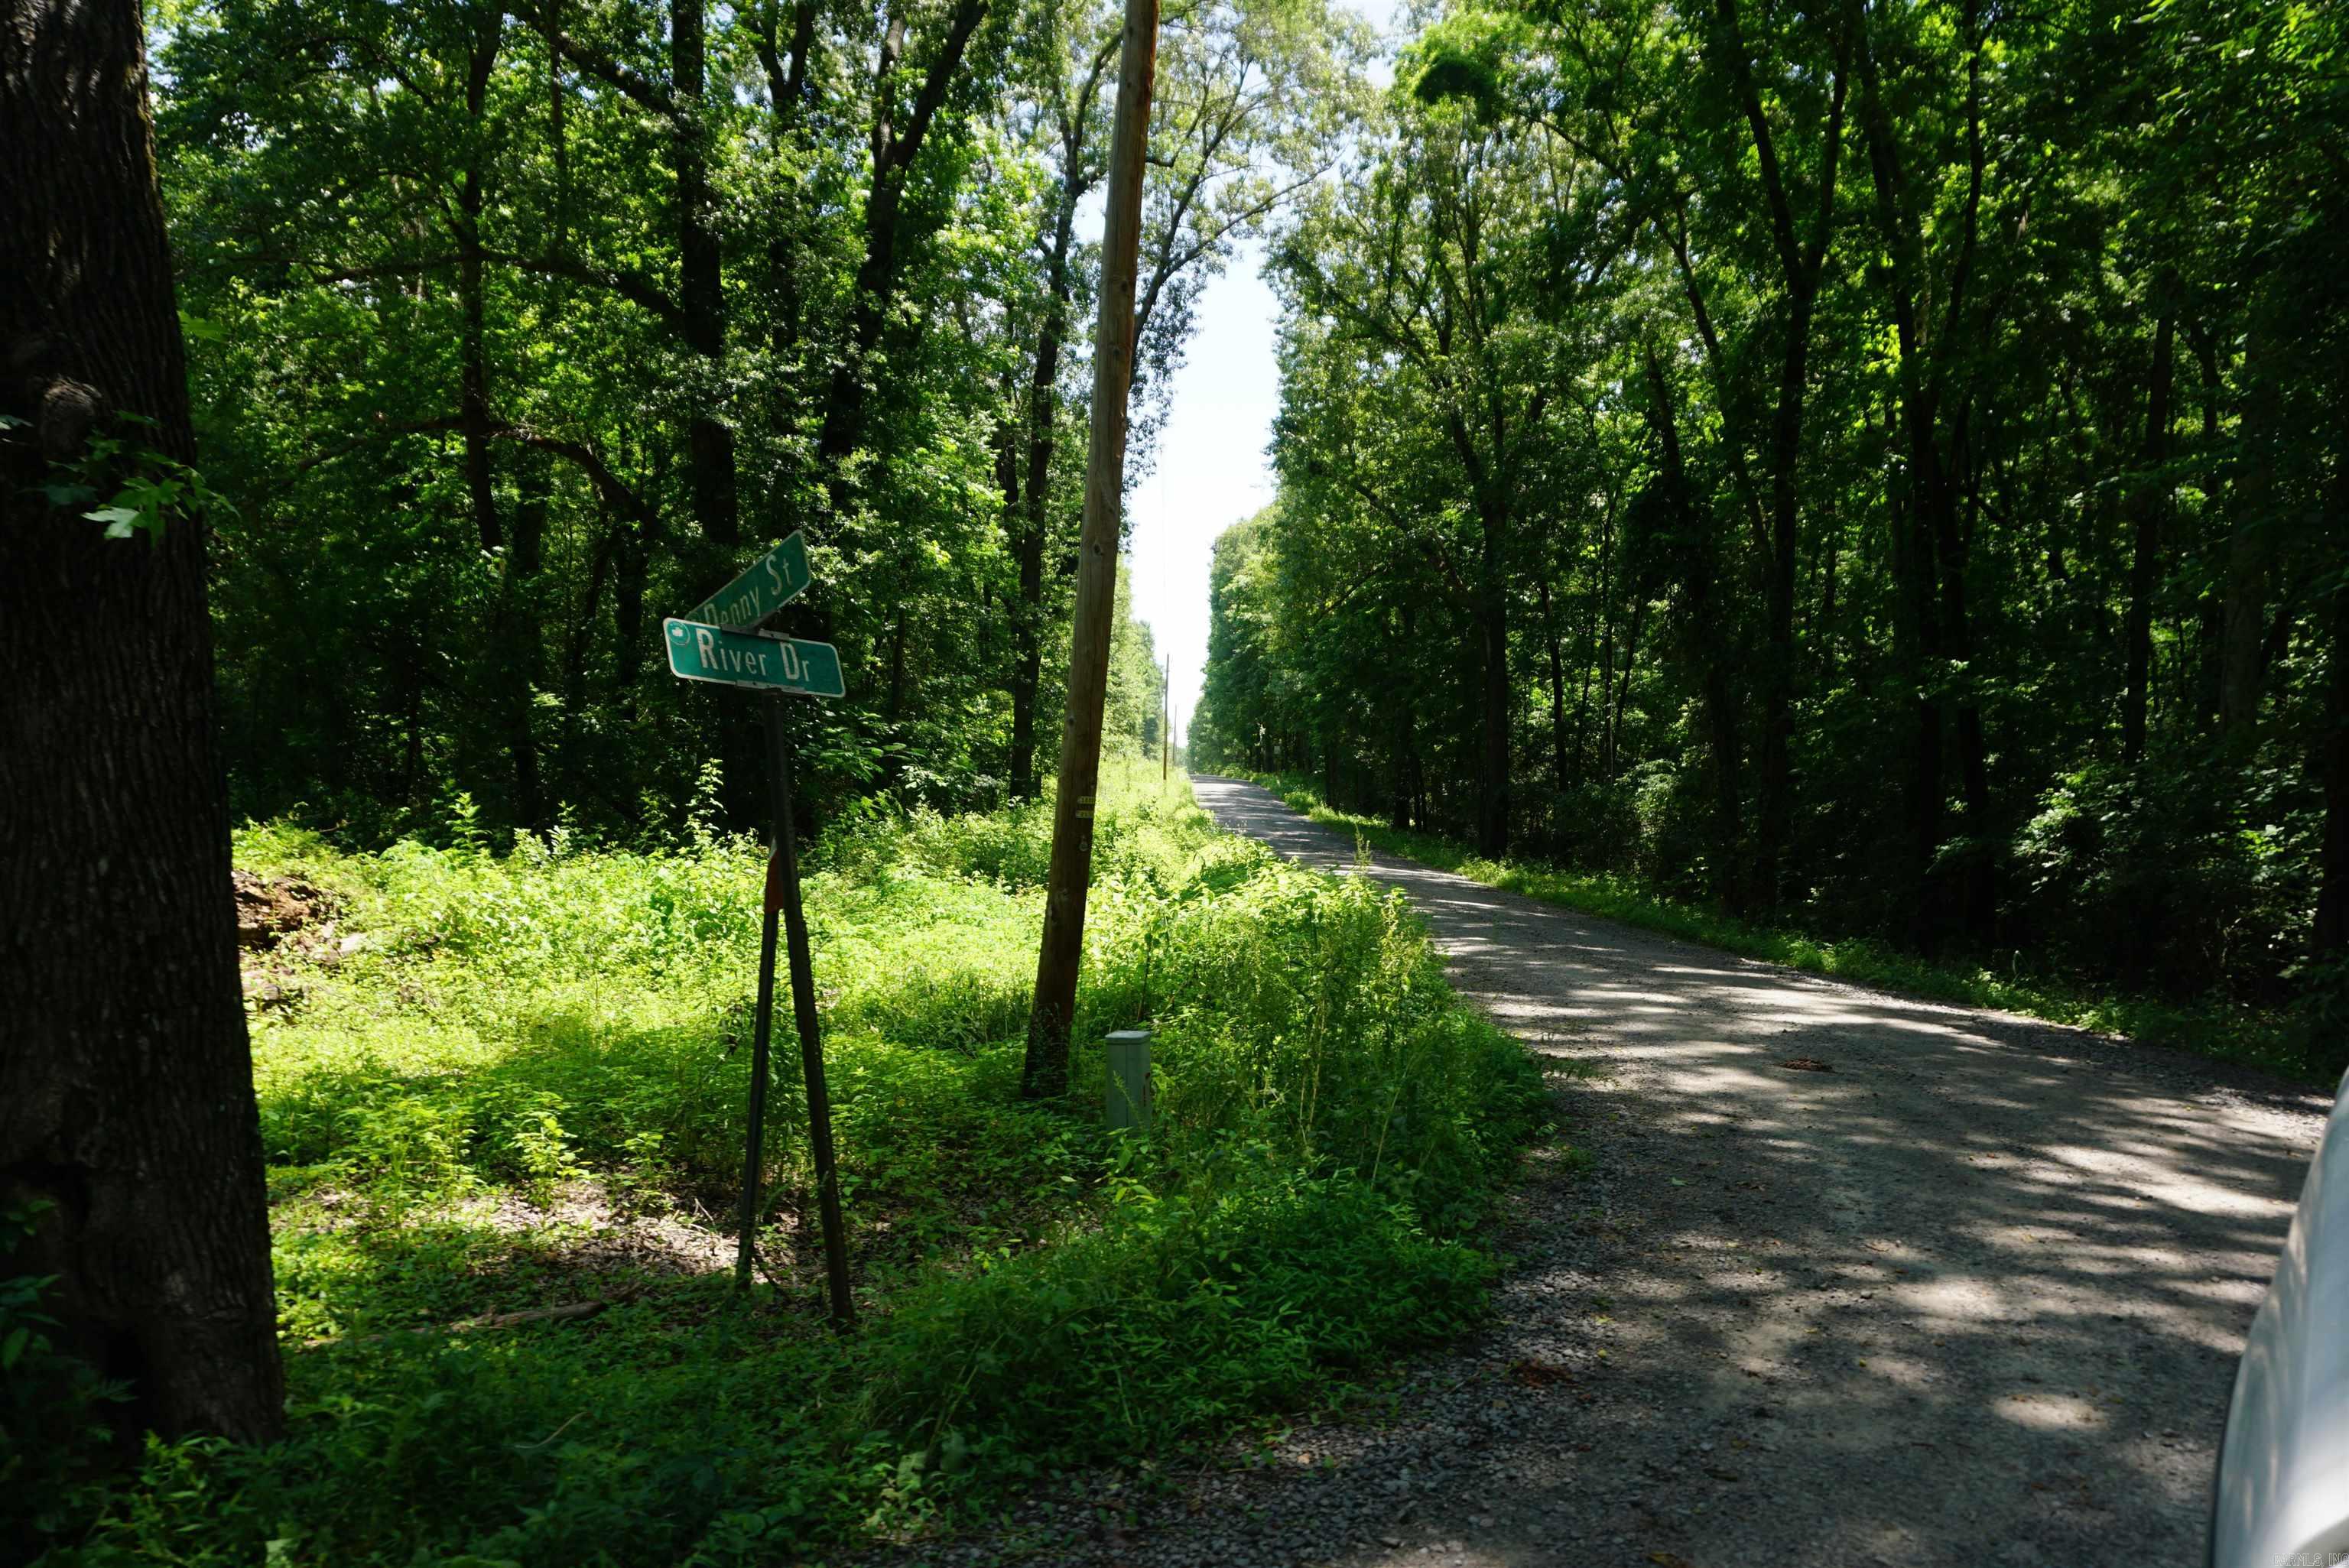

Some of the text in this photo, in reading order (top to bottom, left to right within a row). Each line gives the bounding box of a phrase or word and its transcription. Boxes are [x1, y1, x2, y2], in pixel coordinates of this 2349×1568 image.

[766, 554, 793, 596] St
[696, 628, 809, 682] River Dr
